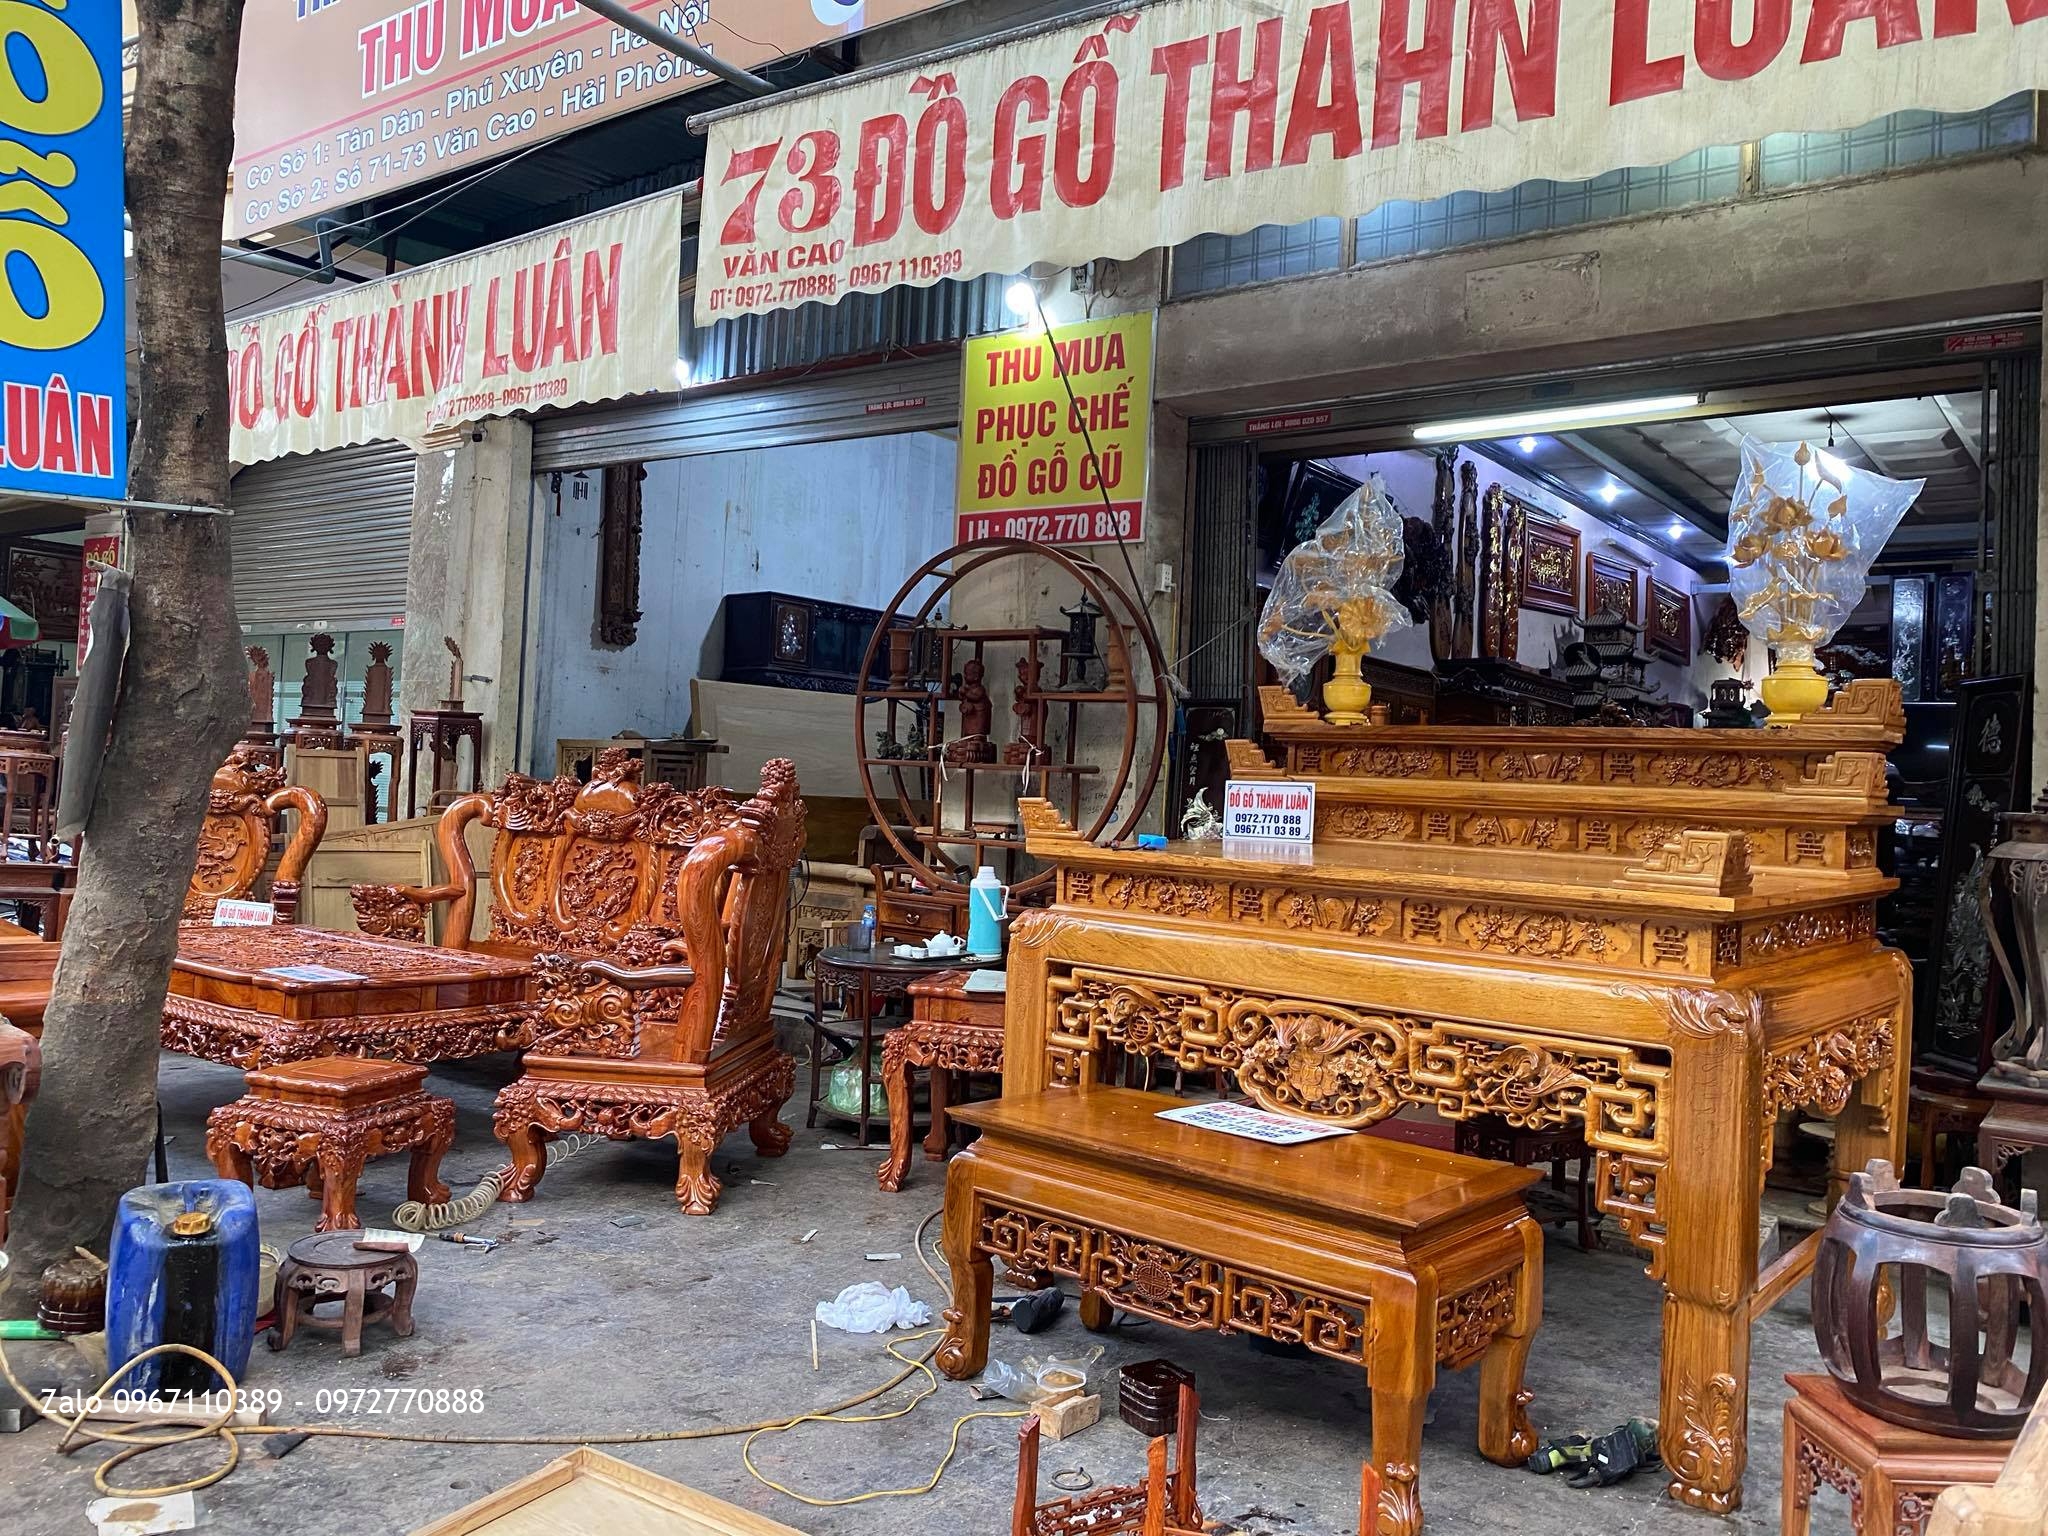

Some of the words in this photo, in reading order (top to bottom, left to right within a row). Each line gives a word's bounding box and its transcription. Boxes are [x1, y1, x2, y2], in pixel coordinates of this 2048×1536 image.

[358, 0, 447, 99] THU
[460, 0, 580, 60] MU
[245, 201, 272, 224] Cơ
[278, 185, 306, 214] Sở
[310, 178, 329, 203] 2:
[335, 159, 362, 194] Số
[369, 141, 427, 183] 71-73
[433, 126, 479, 160] Văn
[486, 107, 537, 141] Cao
[561, 74, 606, 117] Hải
[247, 165, 274, 189] Cơ
[279, 149, 307, 178] Sở
[314, 142, 329, 165] 1:
[336, 128, 374, 157] Tân
[381, 109, 424, 142] Dân
[446, 76, 494, 118] Phú
[499, 49, 583, 99] Xuyên
[720, 130, 842, 246] 73
[852, 71, 967, 248] ĐỒ
[990, 13, 1140, 221] GỖ
[723, 247, 779, 279] VĂN
[787, 239, 845, 270] CAO
[274, 303, 330, 424] GỖ
[332, 282, 472, 413] THÀNH
[482, 237, 624, 379] LUÂN
[986, 346, 1042, 387] THU
[1053, 332, 1126, 379] MUA
[0, 373, 114, 478] UÂN
[976, 400, 1057, 447] PHỤC
[1068, 376, 1135, 434] CHẾ
[978, 449, 1017, 499] ĐỒ
[1027, 442, 1068, 495] GỖ
[1079, 443, 1123, 491] CŨ
[1094, 510, 1132, 538] 888
[1234, 824, 1271, 835] 0967.11
[1274, 826, 1286, 836] 03
[1289, 827, 1301, 836] 89
[1235, 813, 1280, 824] 0972.770
[1283, 815, 1301, 824] 888
